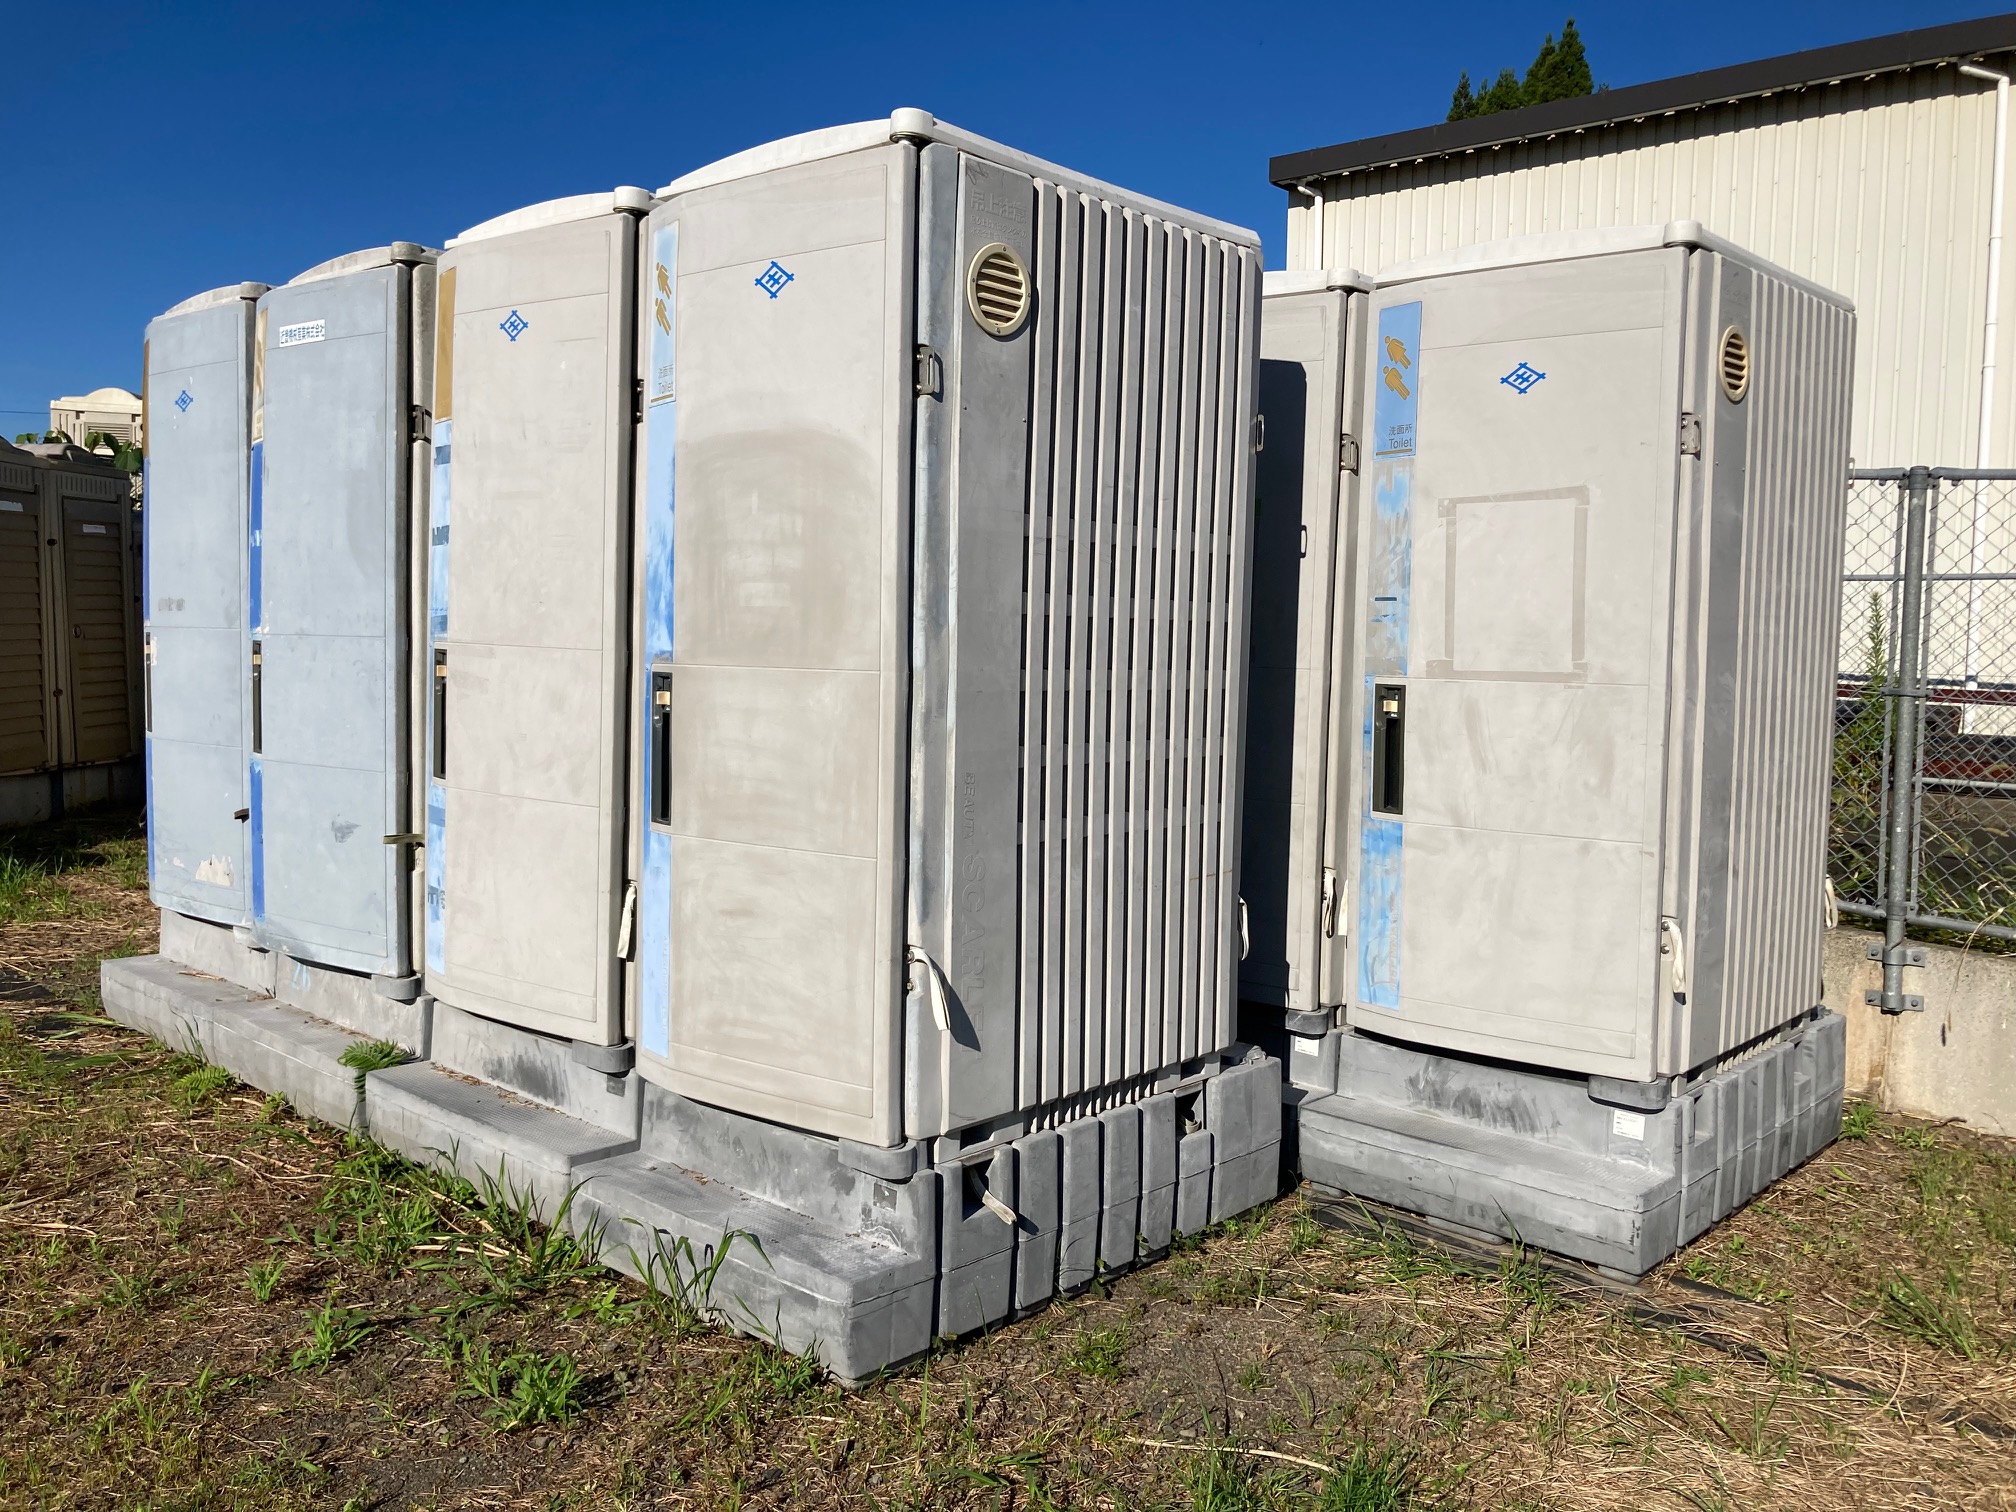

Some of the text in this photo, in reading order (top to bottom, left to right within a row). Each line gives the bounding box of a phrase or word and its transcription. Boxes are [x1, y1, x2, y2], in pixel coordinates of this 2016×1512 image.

[657, 381, 674, 395] Toilet
[1388, 423, 1413, 436] 洗面所
[1388, 437, 1413, 449] Toilet
